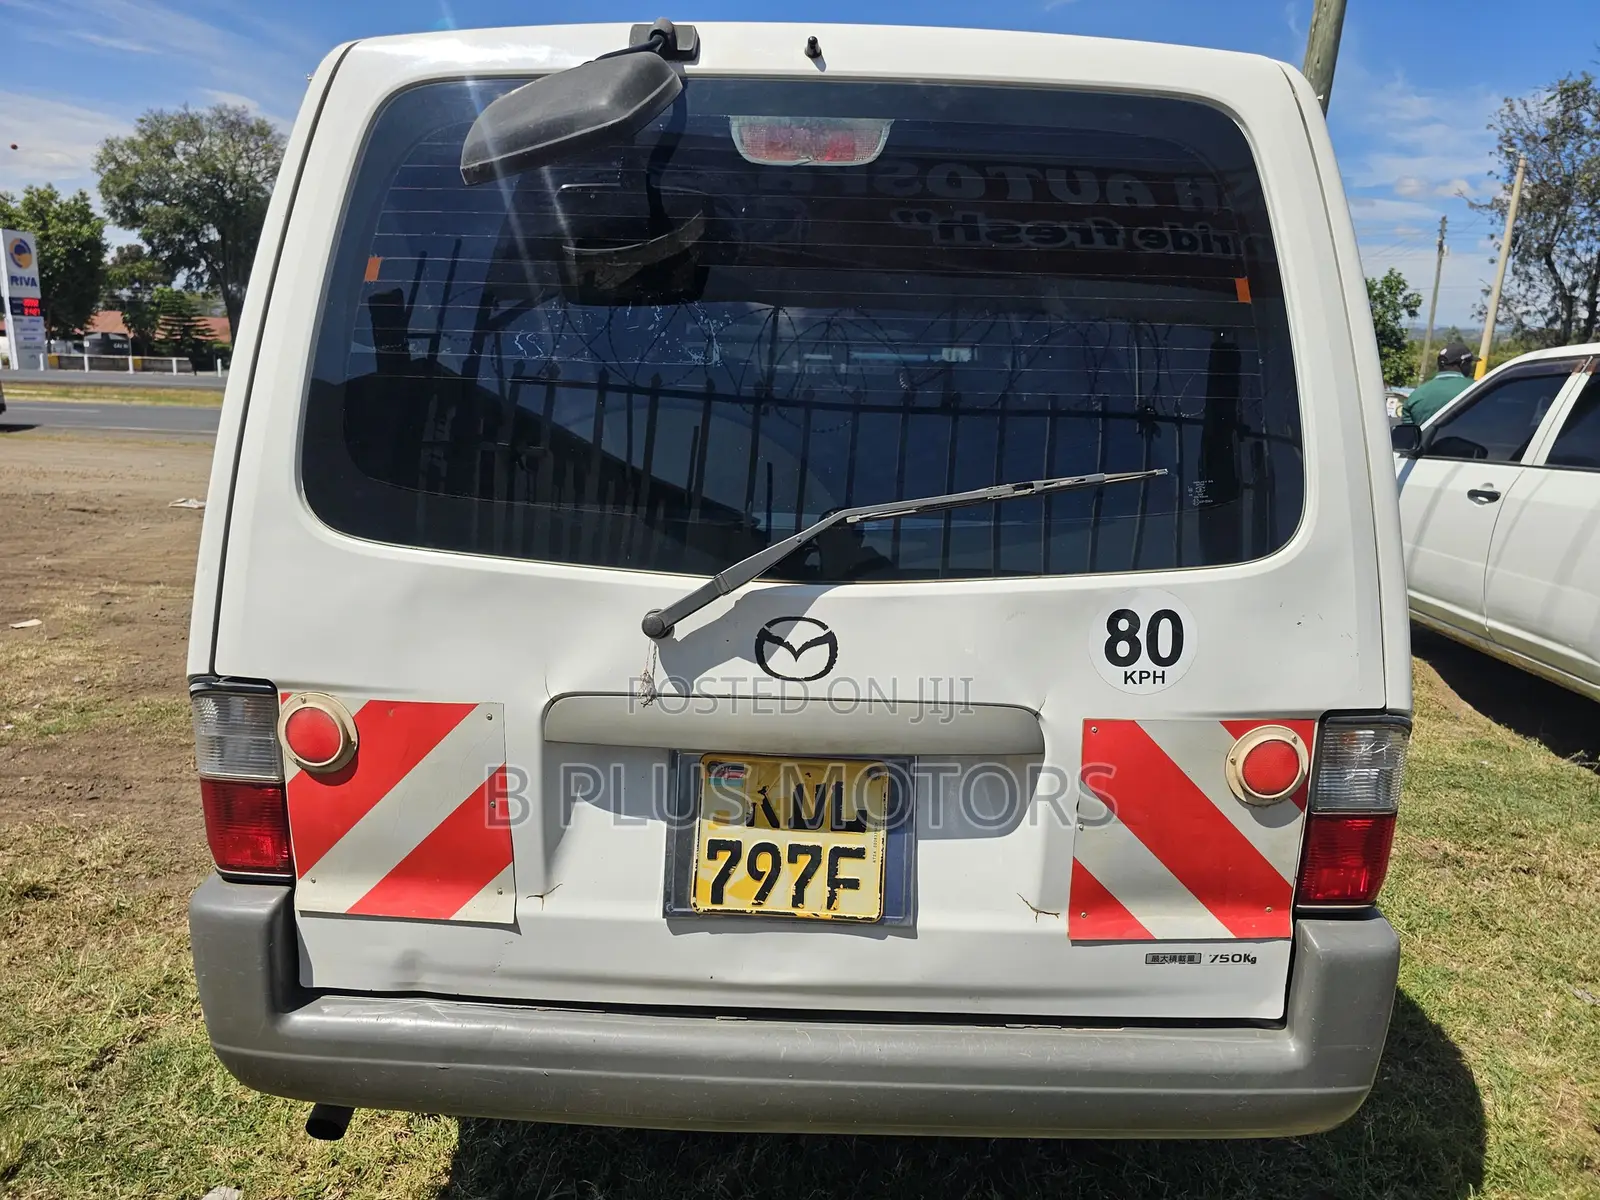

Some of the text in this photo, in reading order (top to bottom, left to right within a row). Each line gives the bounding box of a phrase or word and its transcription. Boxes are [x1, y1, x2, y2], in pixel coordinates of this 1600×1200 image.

[10, 275, 38, 287] RIVA
[1104, 608, 1184, 667] 80
[1123, 670, 1166, 684] KPH
[706, 838, 867, 910] 797F
